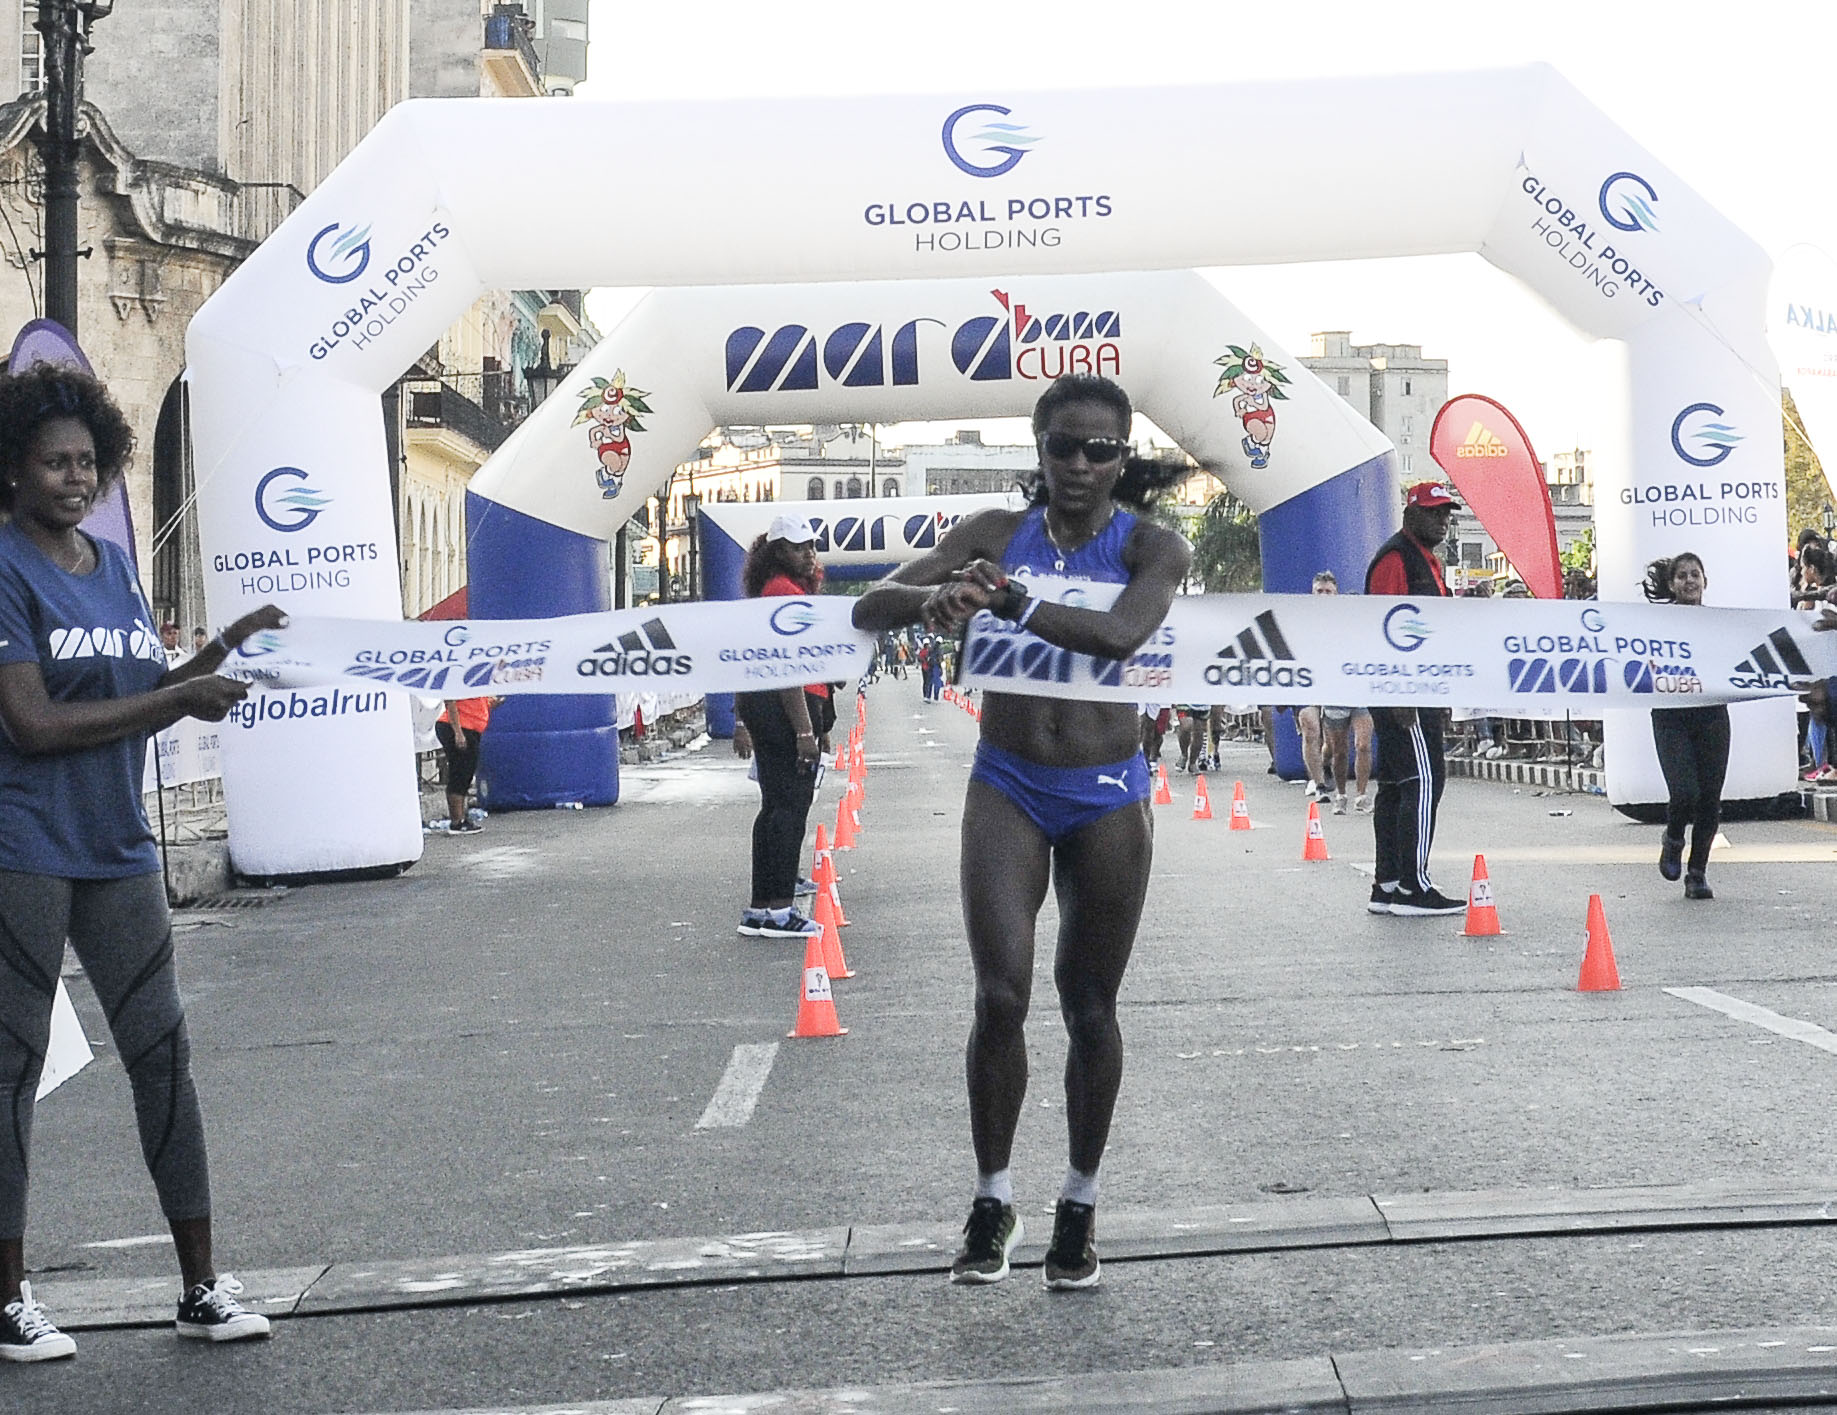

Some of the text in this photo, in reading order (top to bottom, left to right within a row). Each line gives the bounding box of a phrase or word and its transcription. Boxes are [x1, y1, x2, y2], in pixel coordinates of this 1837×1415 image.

[864, 195, 1113, 225] GLOBAL PORTS
[915, 227, 1062, 252] HOLDING
[1522, 176, 1664, 307] GLOBAL PORTS
[1531, 217, 1620, 298] HOLDING
[309, 222, 450, 360] GLOBAL PORTS
[352, 265, 439, 351] HOLDING
[1016, 343, 1121, 379] CUBA
[1620, 482, 1779, 505] GLOBAL PORTS
[1652, 506, 1758, 527] HOLDING
[214, 543, 378, 572] GLOBAL PORTS
[241, 569, 350, 594] HOLDING
[355, 640, 552, 665] GLOBAL PORTS
[719, 643, 857, 663] GLOBAL PORTS
[1504, 635, 1693, 659] GLOBAL PORTS
[577, 650, 692, 677] adidas
[1204, 659, 1313, 687] adidas
[1342, 662, 1475, 678] GLOBAL PORTS
[1371, 681, 1450, 695] HOLDING
[1654, 676, 1702, 693] CUBA
[229, 689, 387, 729] #globalrun
